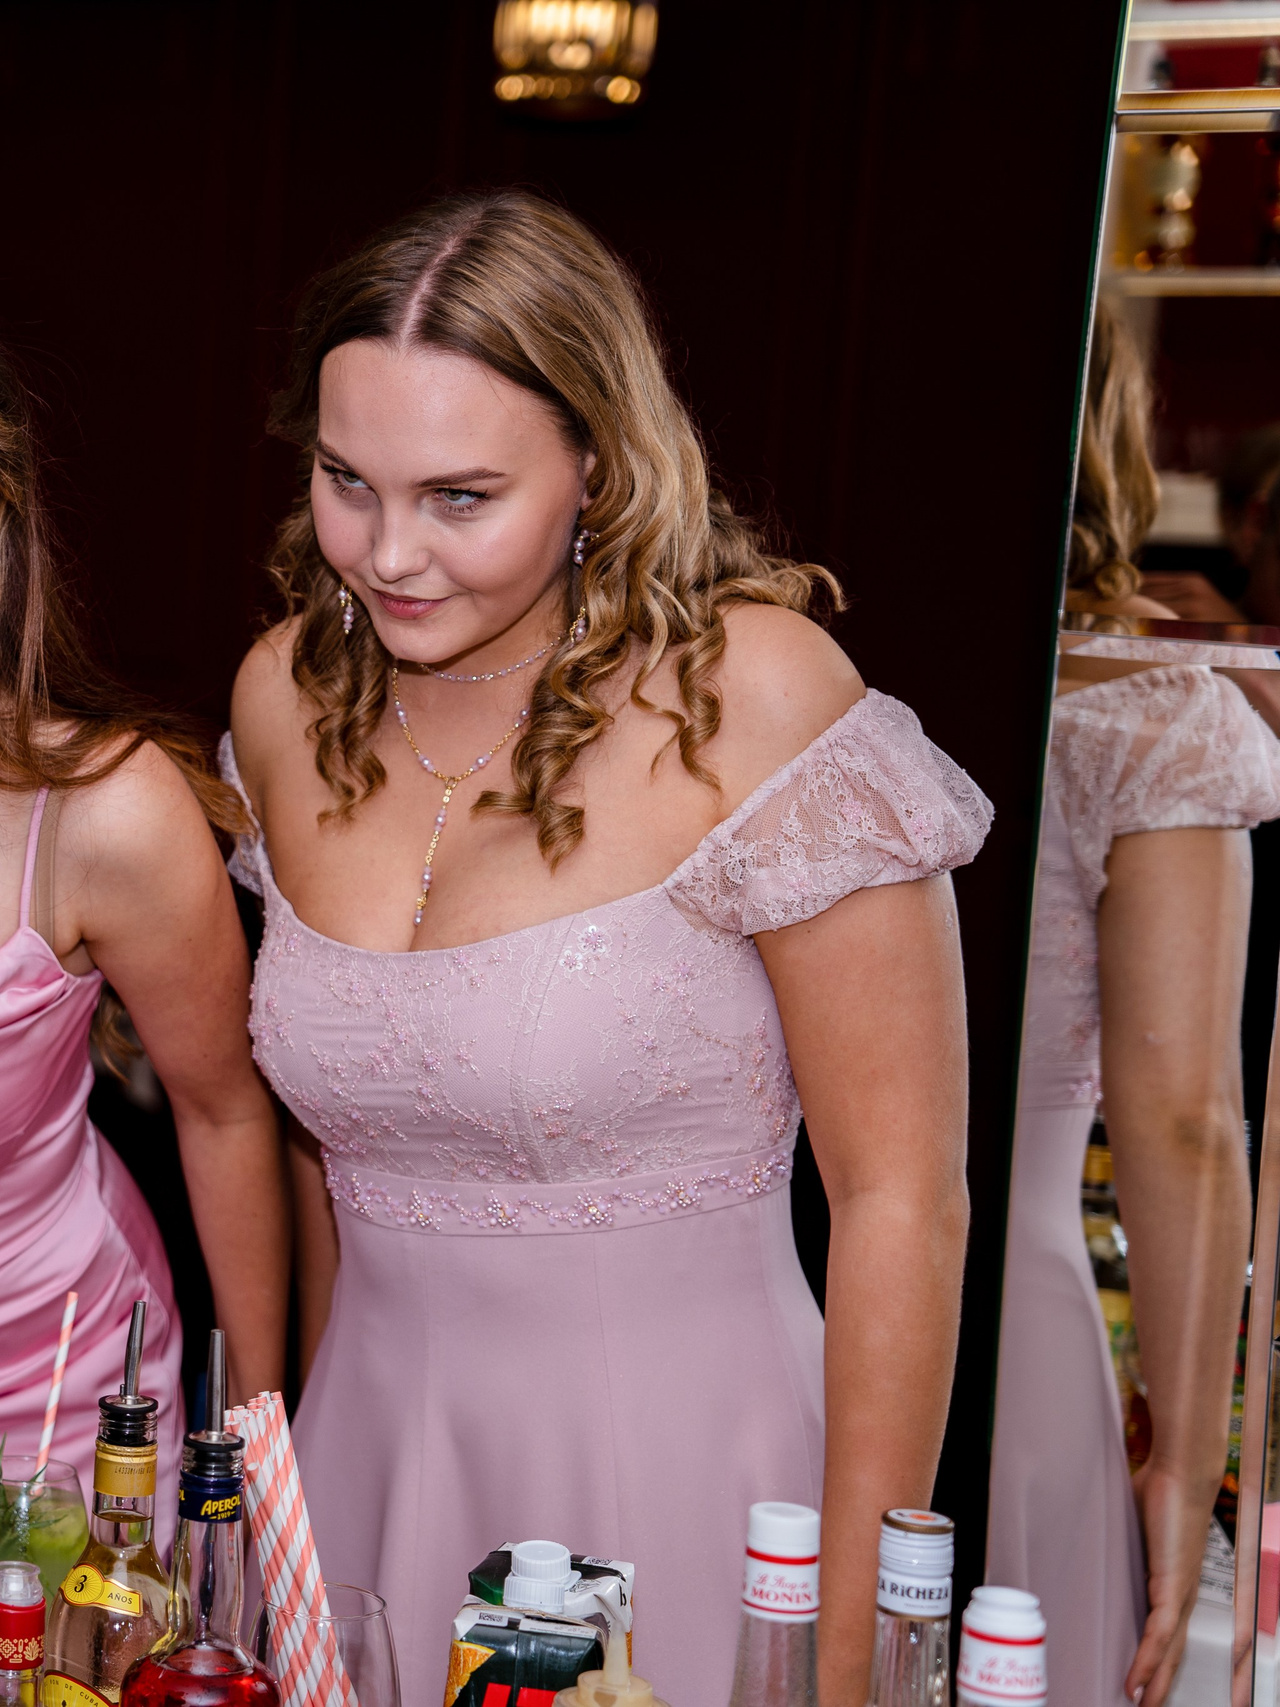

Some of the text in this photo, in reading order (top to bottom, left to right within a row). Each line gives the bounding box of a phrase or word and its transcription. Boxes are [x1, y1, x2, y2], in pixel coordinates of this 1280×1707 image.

[200, 1494, 241, 1516] APEROL
[217, 1511, 231, 1520] 1919
[74, 1574, 133, 1605] 3 AÑOS
[751, 1586, 813, 1604] MONIN
[64, 1683, 73, 1692] DE
[79, 1691, 99, 1707] CUBA
